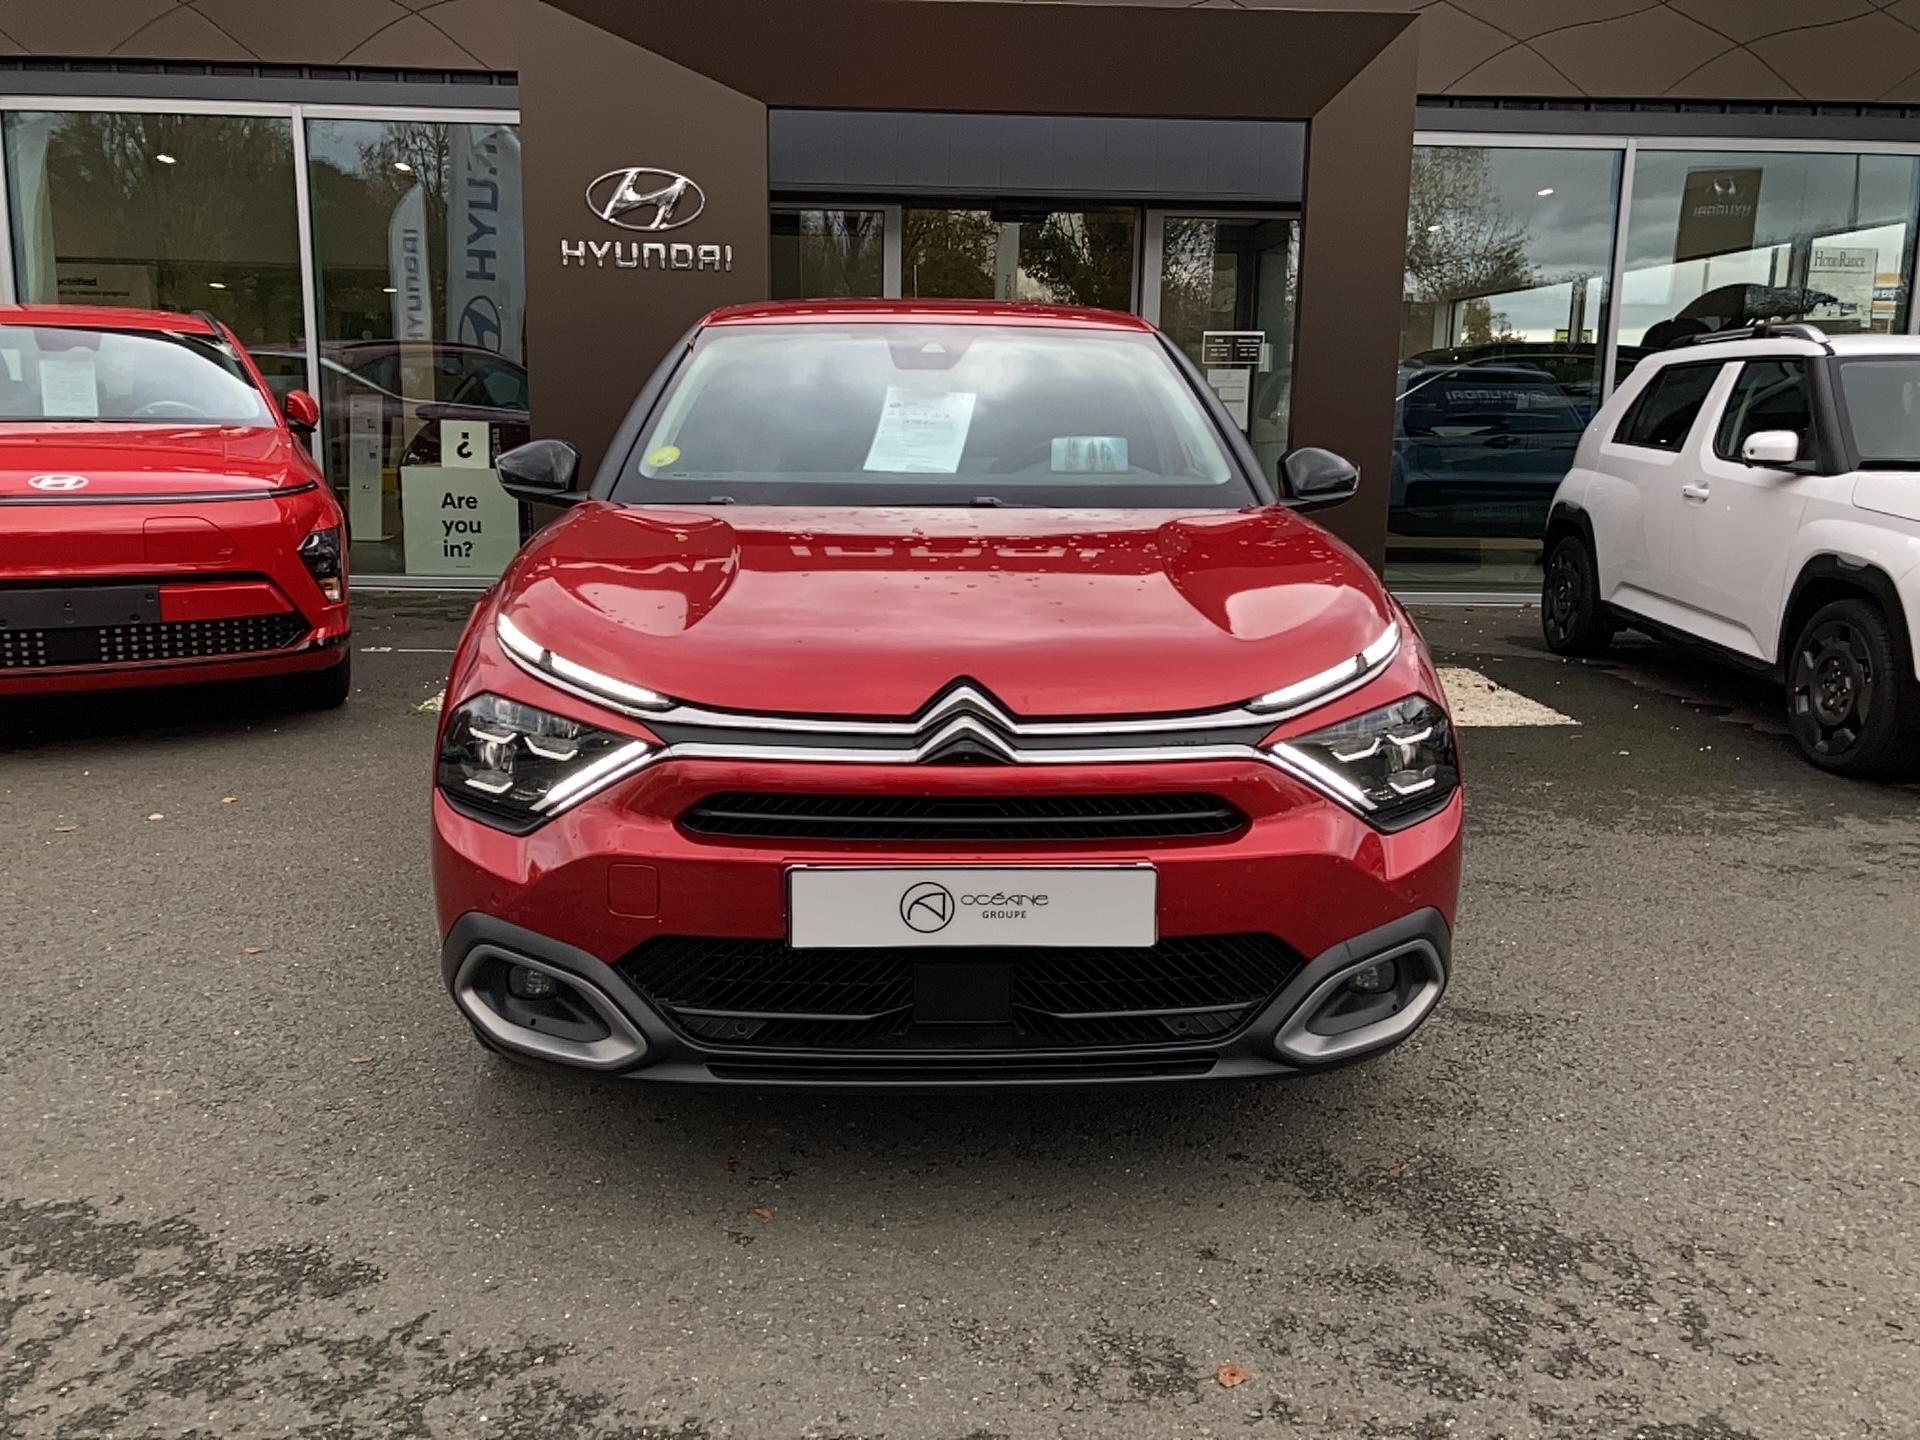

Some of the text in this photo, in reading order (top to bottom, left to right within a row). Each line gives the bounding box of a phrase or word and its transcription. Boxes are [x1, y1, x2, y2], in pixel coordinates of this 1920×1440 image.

[561, 239, 733, 272] HYUNDAI
[441, 493, 478, 509] Are
[441, 519, 482, 537] you
[443, 540, 473, 557] in?
[982, 910, 1027, 919] GROUPE
